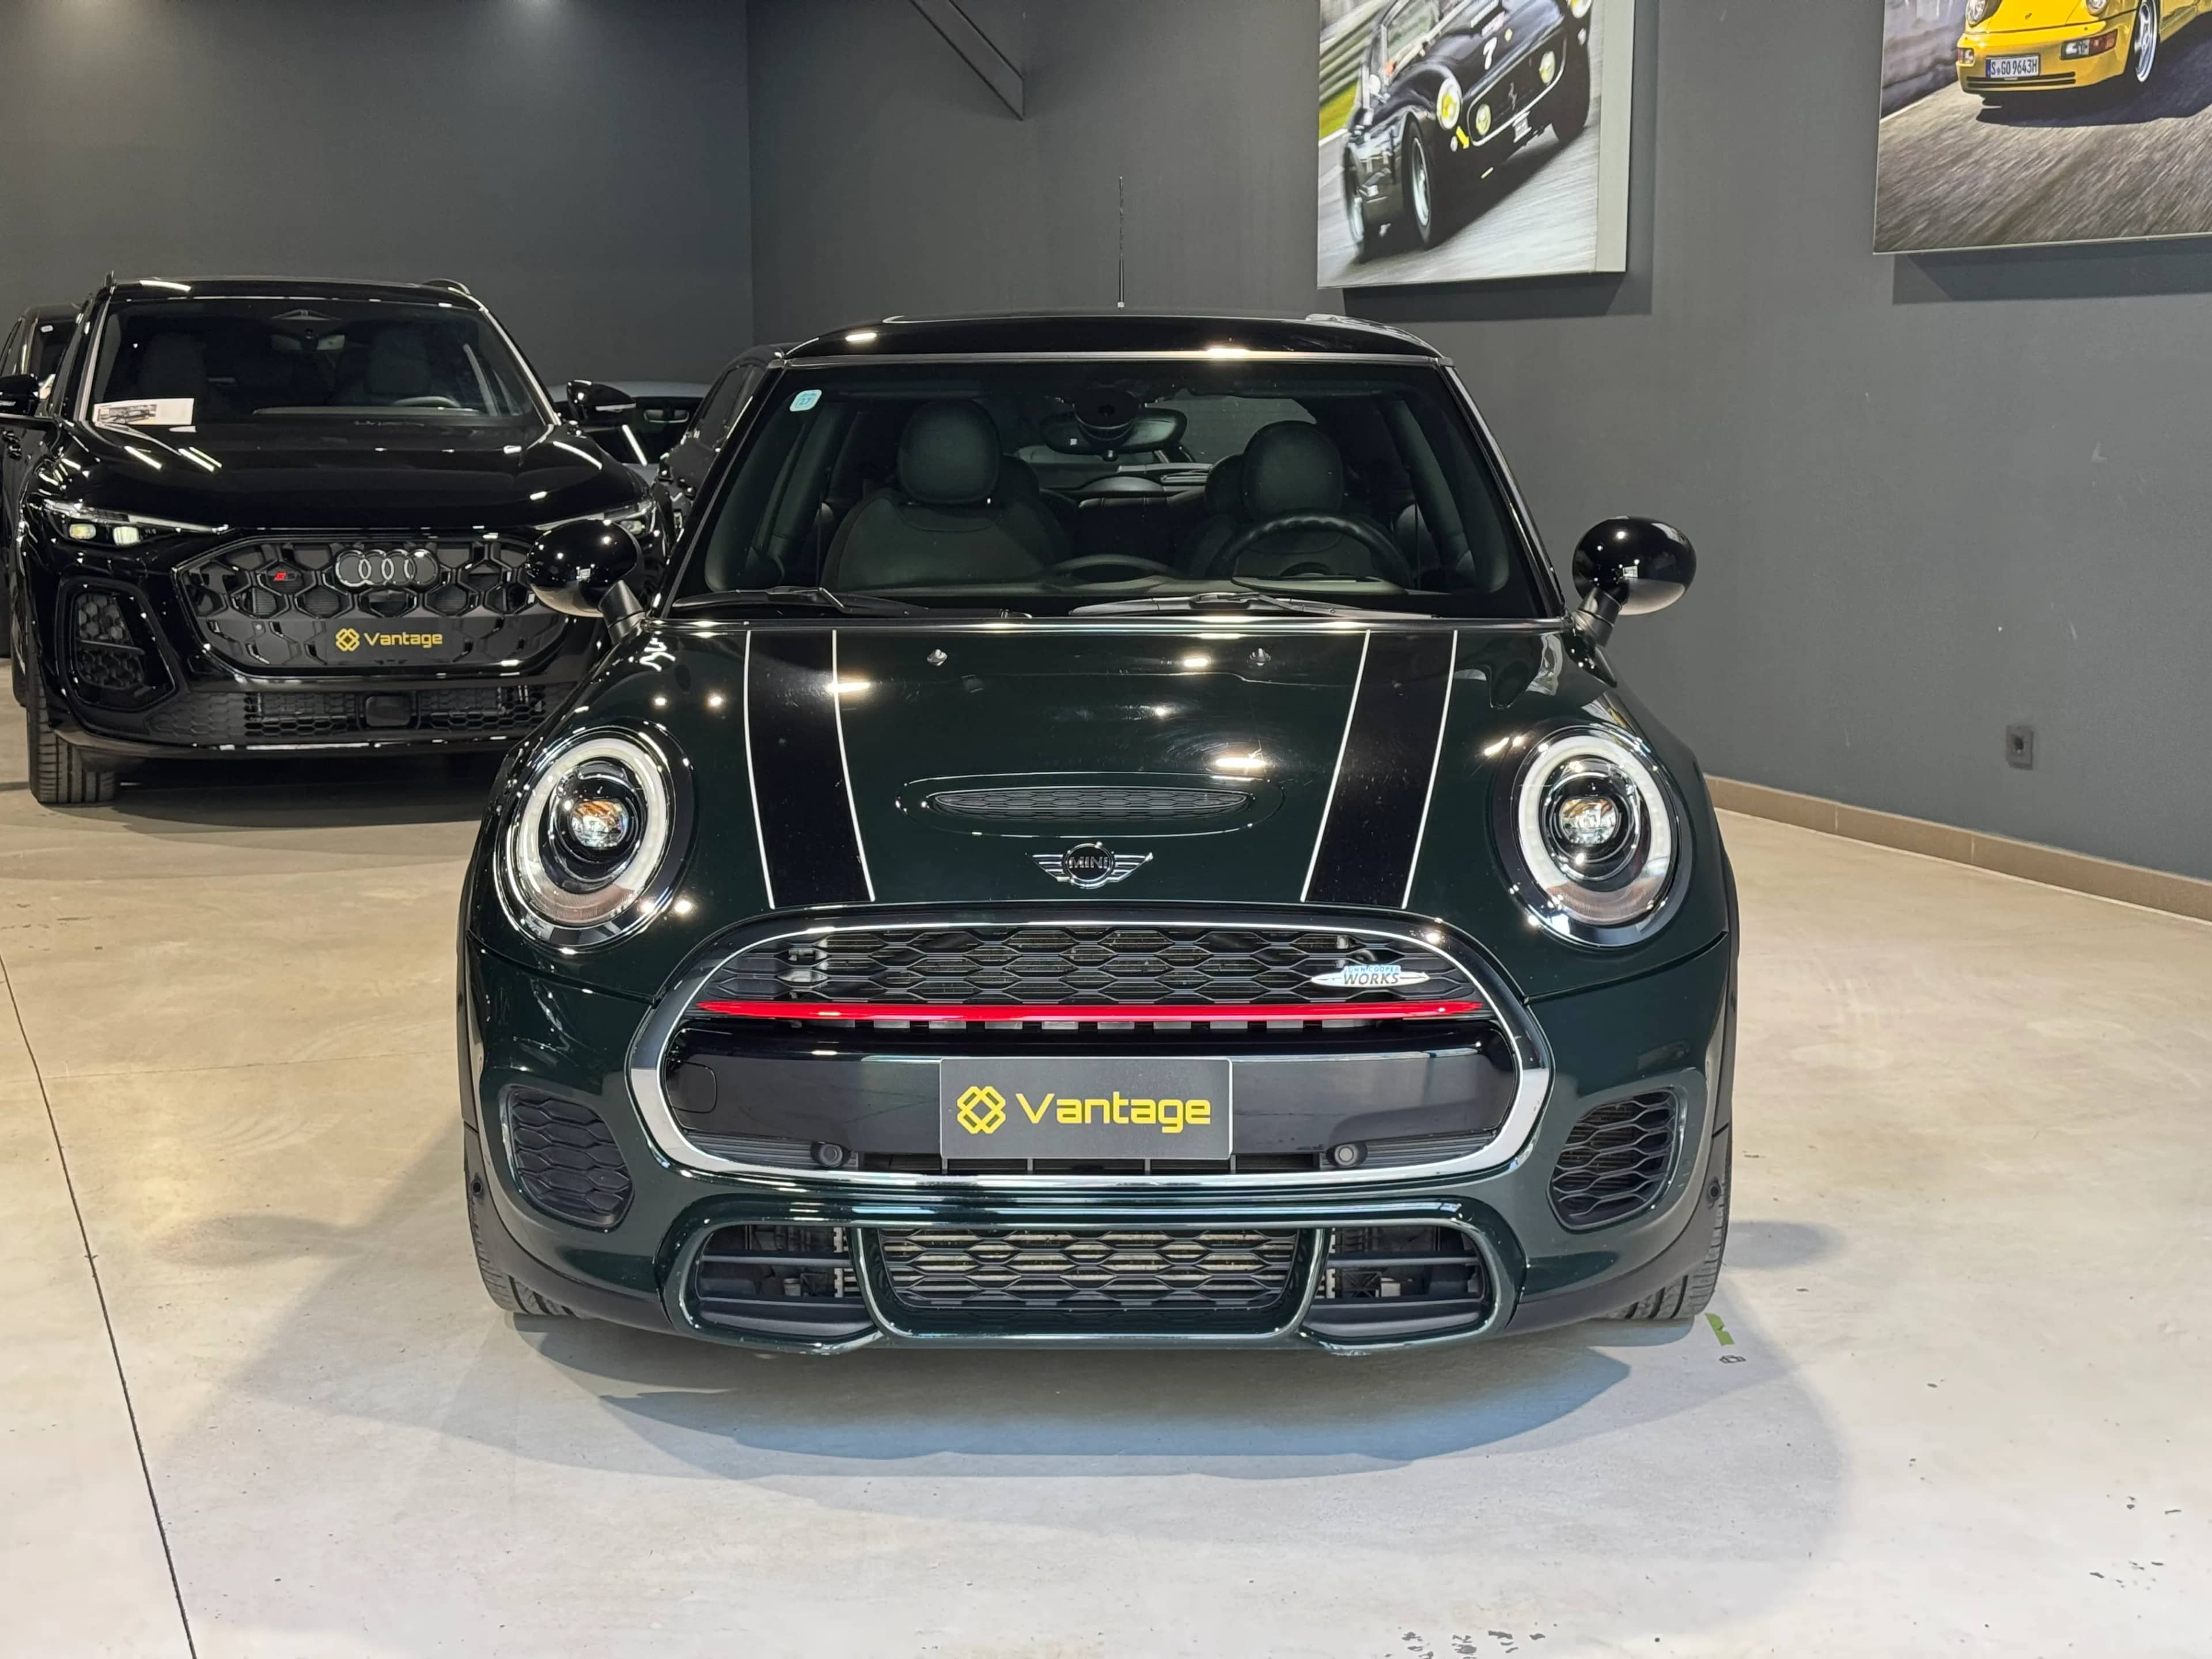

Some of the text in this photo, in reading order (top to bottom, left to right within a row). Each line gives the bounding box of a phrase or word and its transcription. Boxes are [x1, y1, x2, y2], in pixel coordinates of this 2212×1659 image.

[2013, 59, 2037, 74] 9643H
[363, 632, 443, 649] Vantage
[1069, 855, 1108, 869] MINI
[1343, 972, 1400, 985] WORKS
[1015, 1091, 1211, 1134] Vantage
